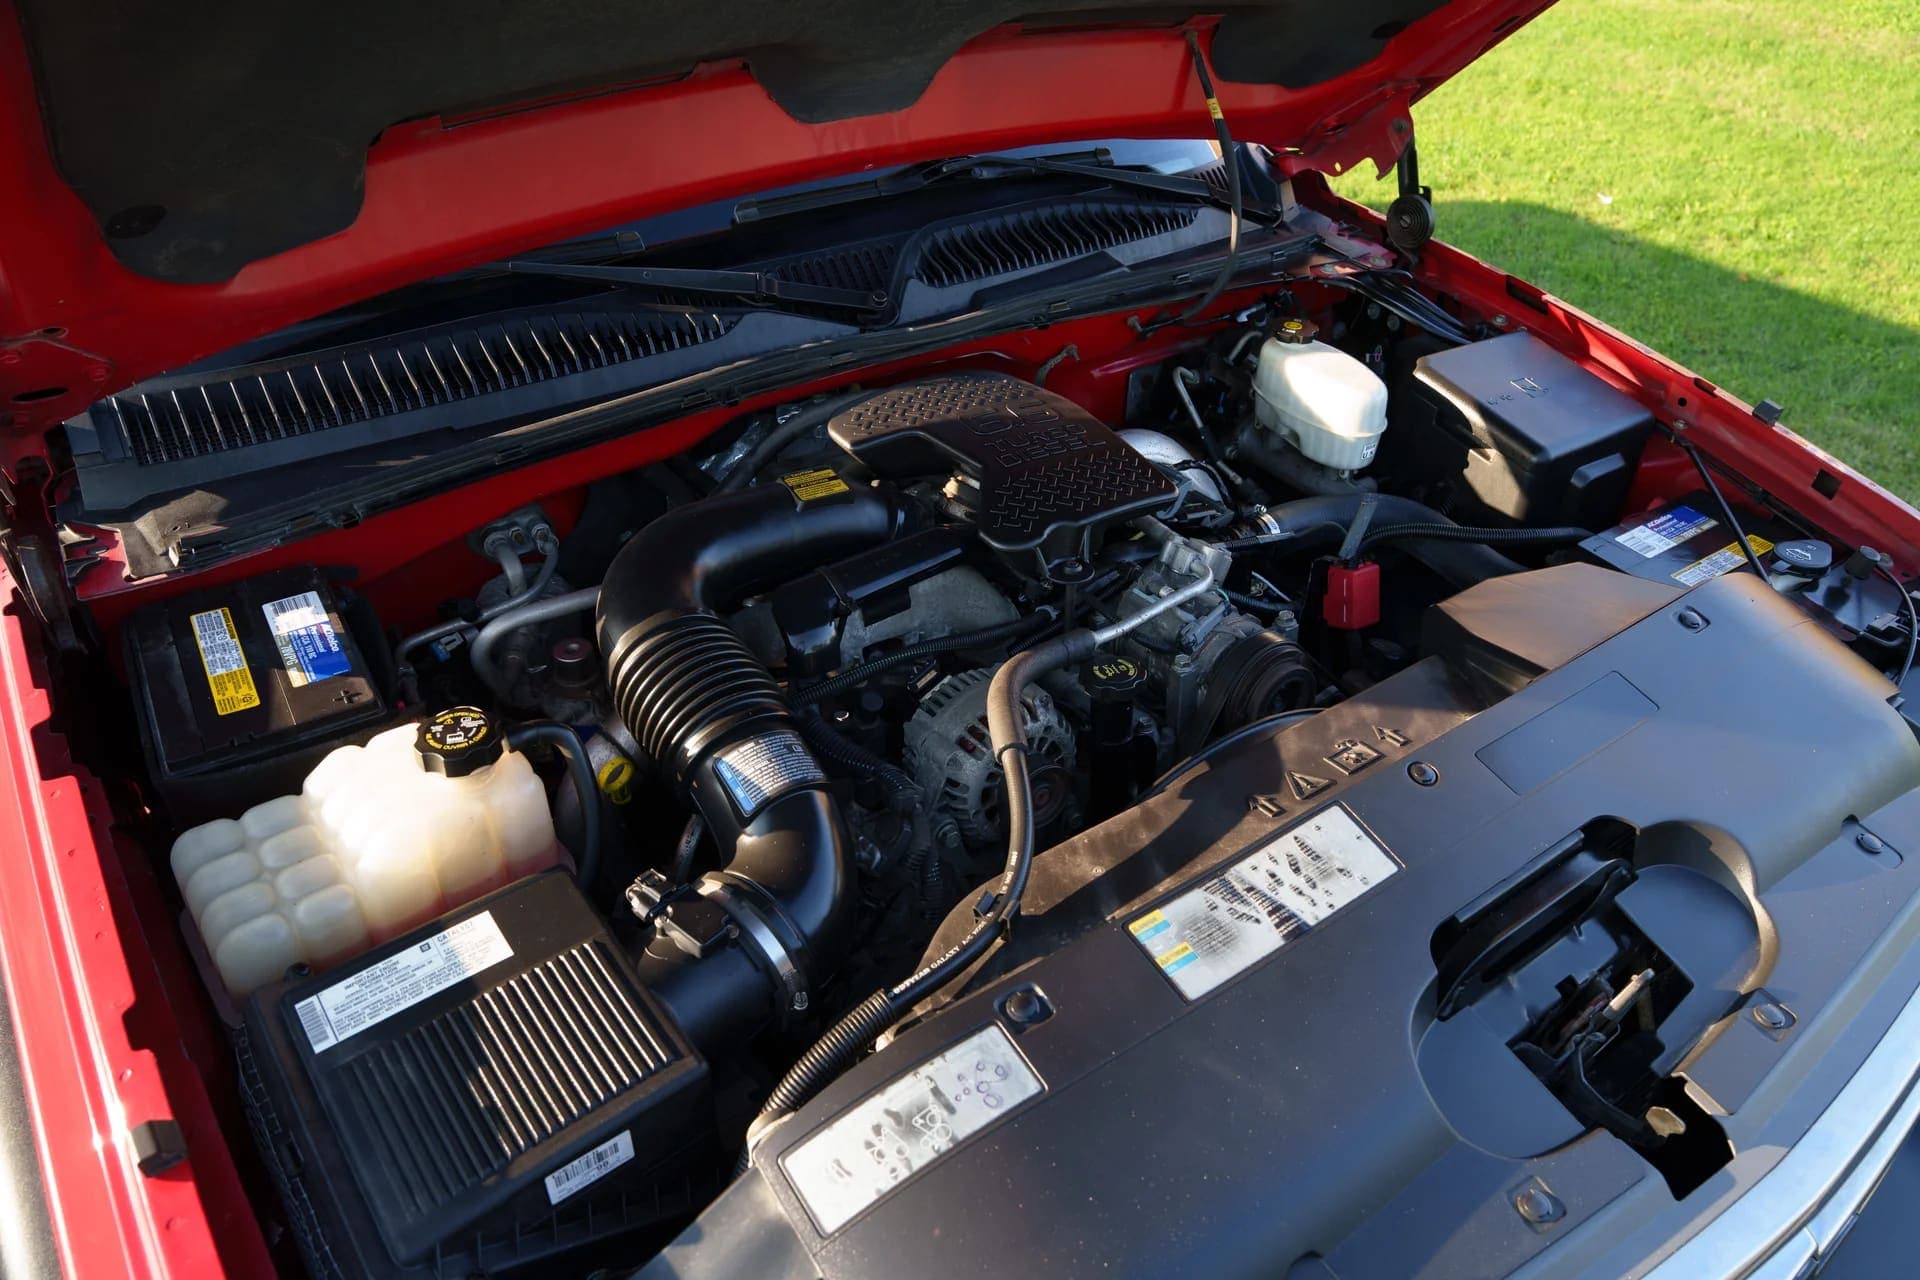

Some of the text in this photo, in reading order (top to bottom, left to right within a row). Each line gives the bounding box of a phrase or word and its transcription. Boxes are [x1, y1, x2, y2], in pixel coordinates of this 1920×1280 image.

[984, 423, 1088, 453] TURBO
[995, 439, 1107, 469] DIESEL
[320, 622, 341, 653] ACDelco
[930, 945, 960, 969] GALAXY
[343, 959, 400, 990] IMPORTANT ENGINE
[357, 966, 398, 988] INFORMATION
